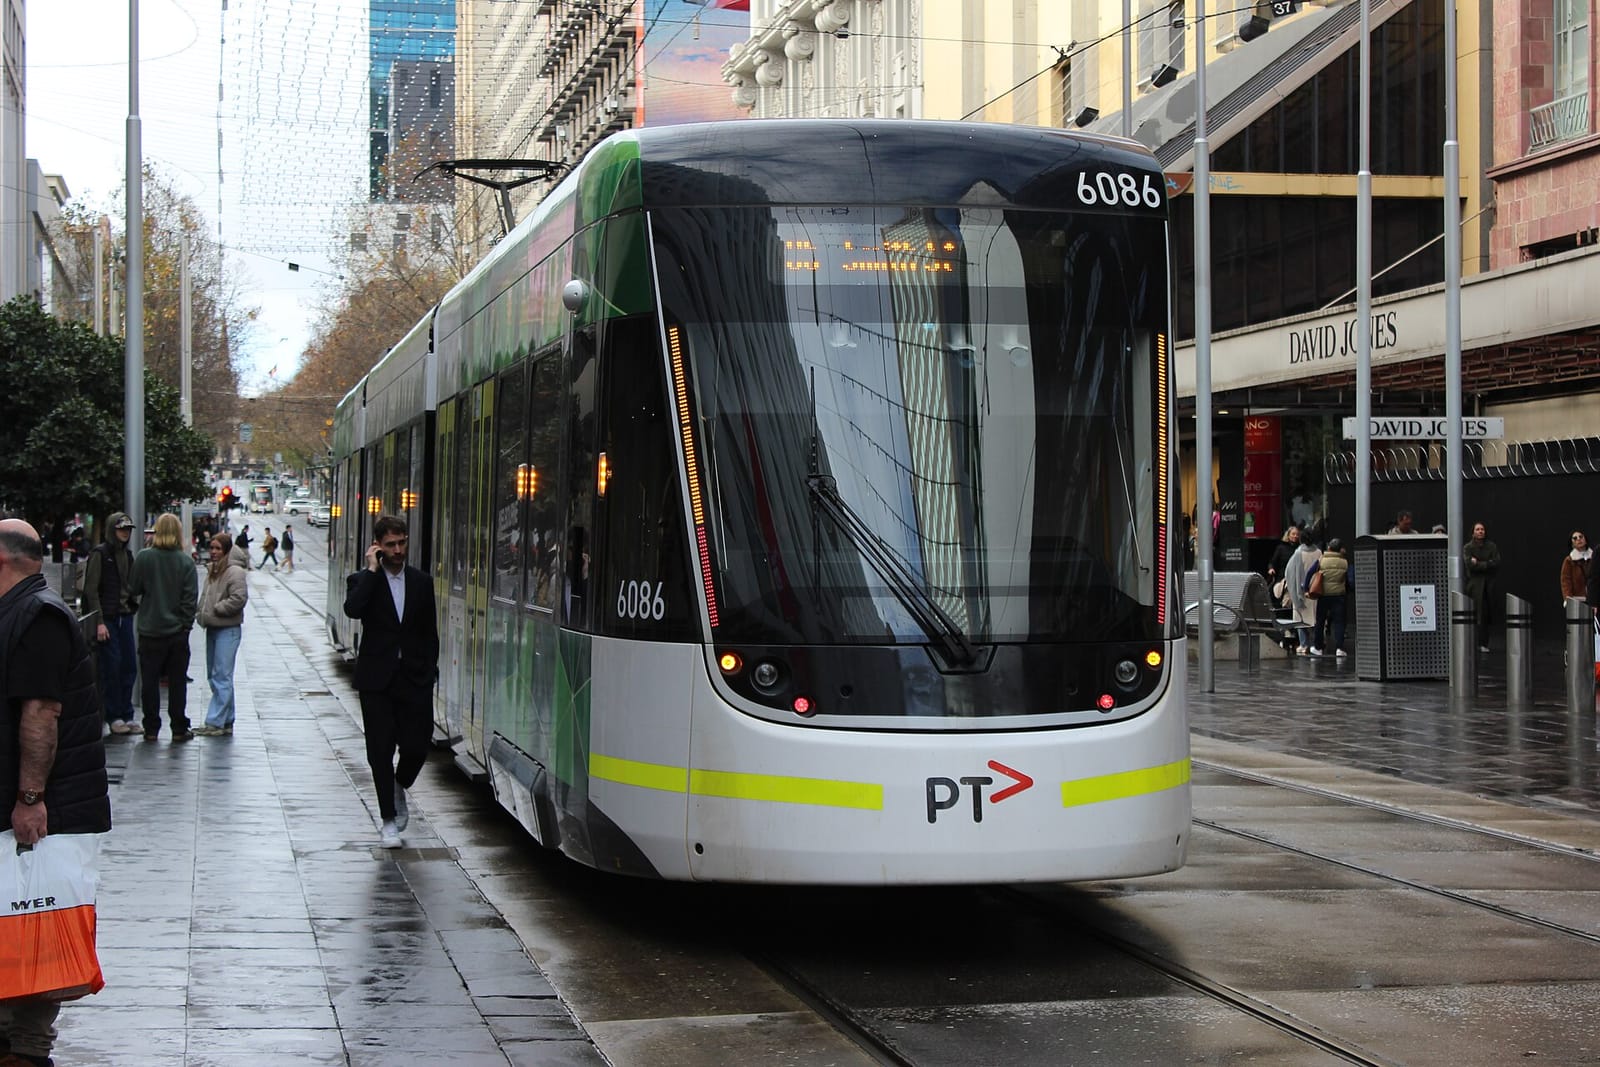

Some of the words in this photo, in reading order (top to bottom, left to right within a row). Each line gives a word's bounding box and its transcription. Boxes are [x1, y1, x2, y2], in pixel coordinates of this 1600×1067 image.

[1274, 1, 1291, 15] 37
[1077, 171, 1161, 208] 6086
[1289, 325, 1337, 364] DAVID
[1340, 311, 1397, 357] JOES
[1427, 420, 1487, 436] JOES
[617, 579, 665, 621] 6086
